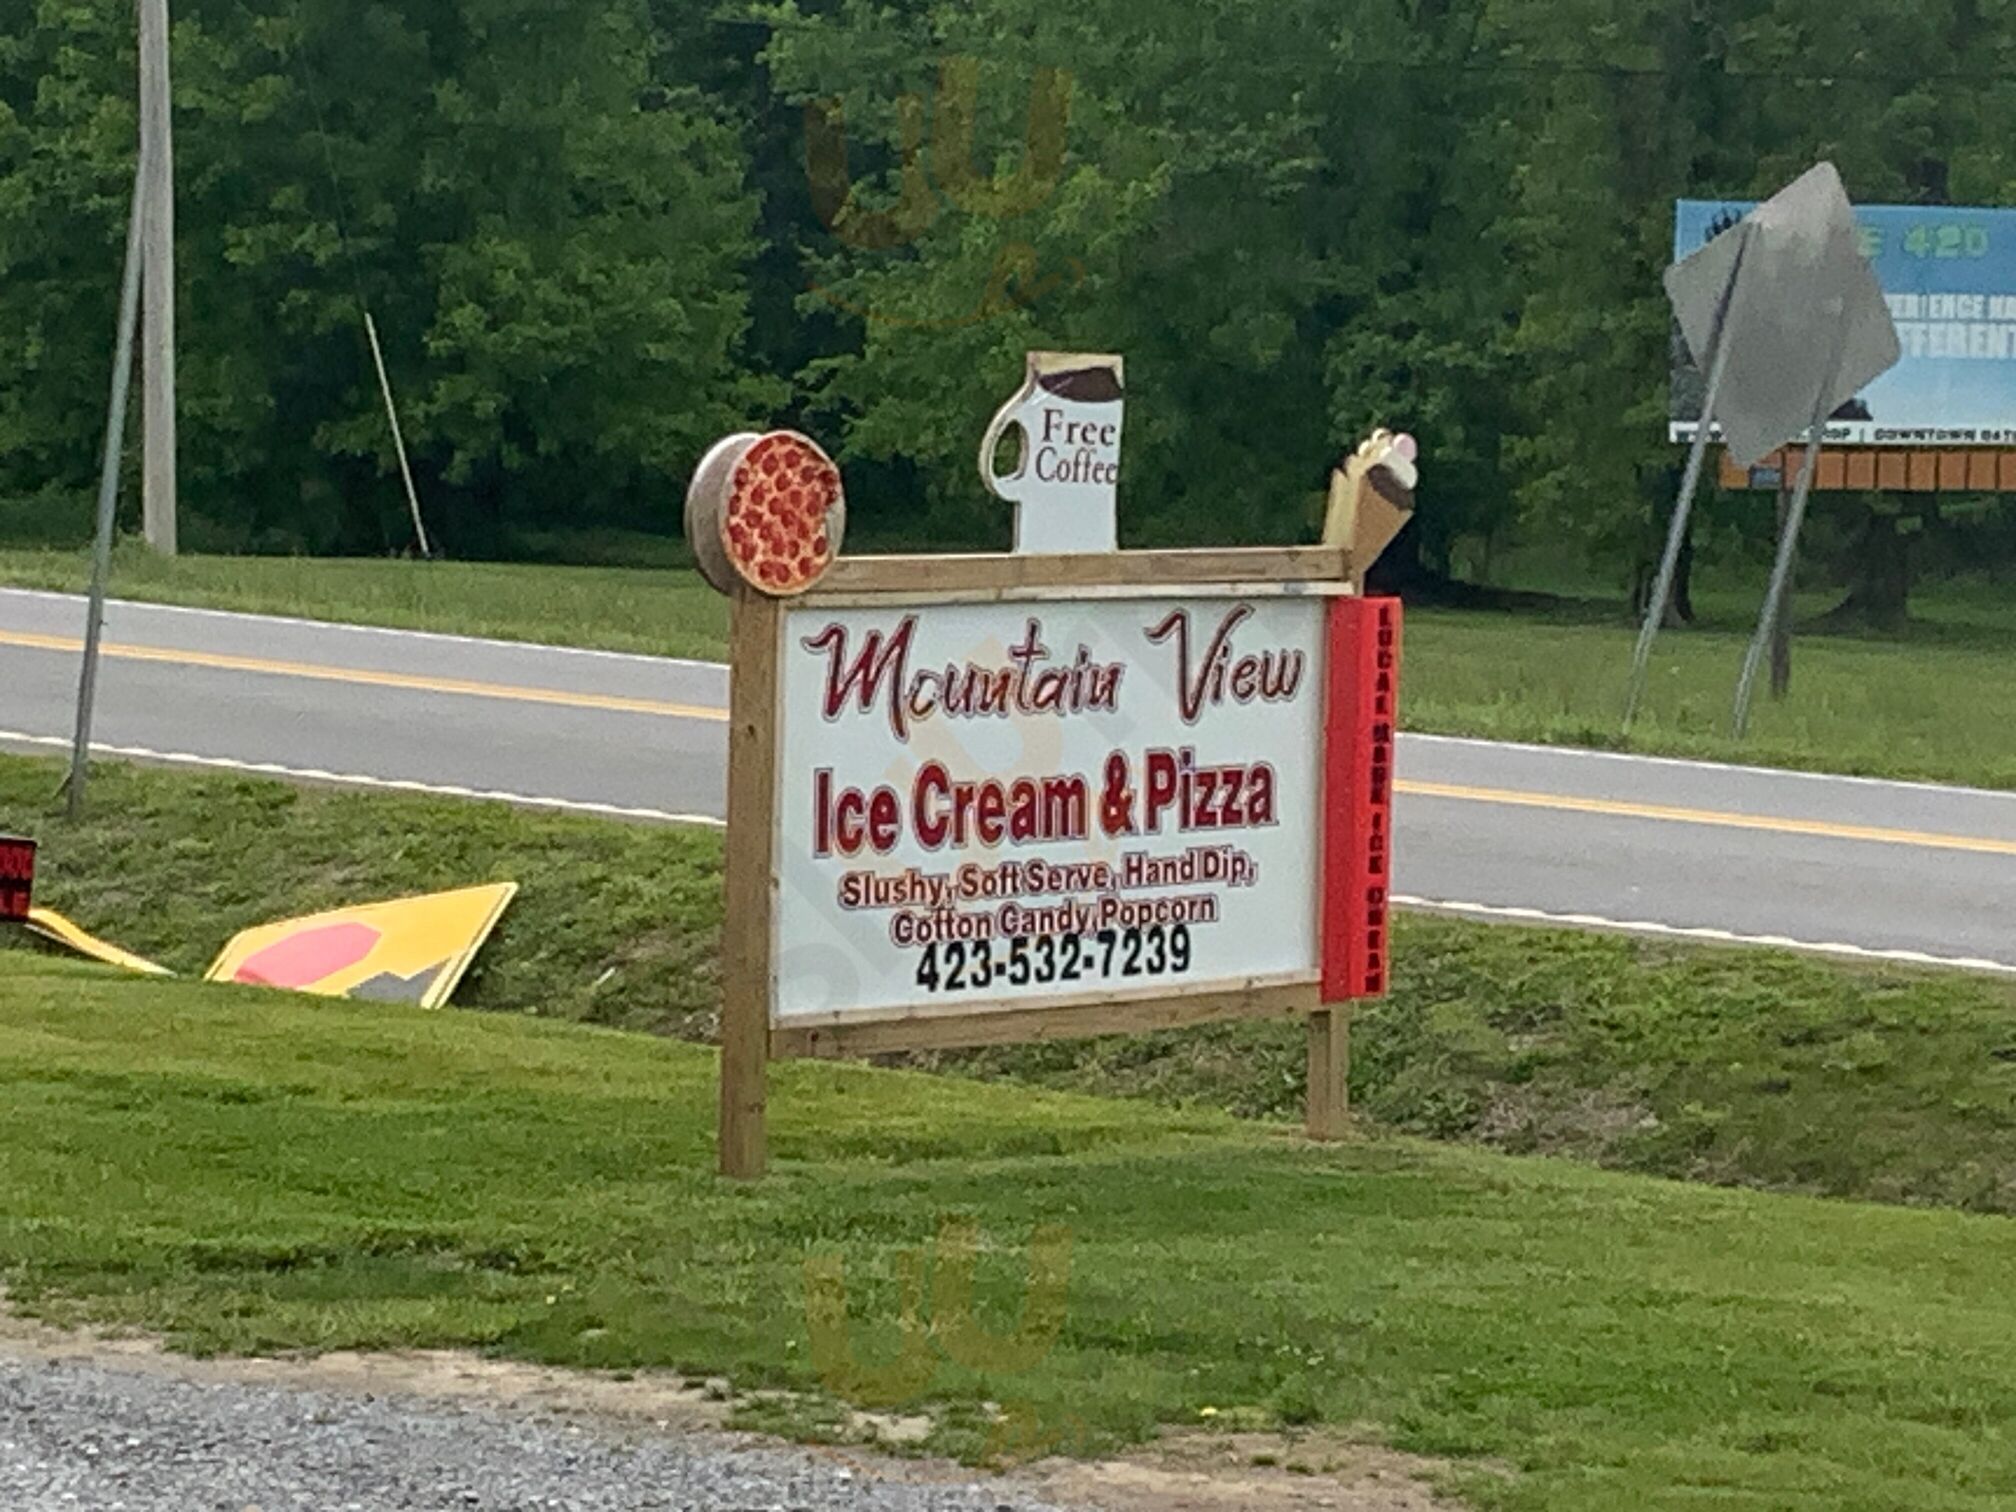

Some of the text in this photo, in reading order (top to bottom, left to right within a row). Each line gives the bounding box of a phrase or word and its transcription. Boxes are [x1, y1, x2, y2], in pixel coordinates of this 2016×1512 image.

[1904, 224, 1990, 258] 420
[1041, 408, 1117, 447] Free
[1874, 428, 1976, 441] DOWNTOWN
[1035, 446, 1119, 485] Coffee
[801, 604, 1304, 743] Mountain View
[814, 747, 1277, 858] Ice Cream & Pizza
[840, 847, 1258, 908] Slushy, Soft Serve, Hand Dip,
[890, 907, 996, 947] Cotton
[915, 923, 1192, 993] 423-532-7239
